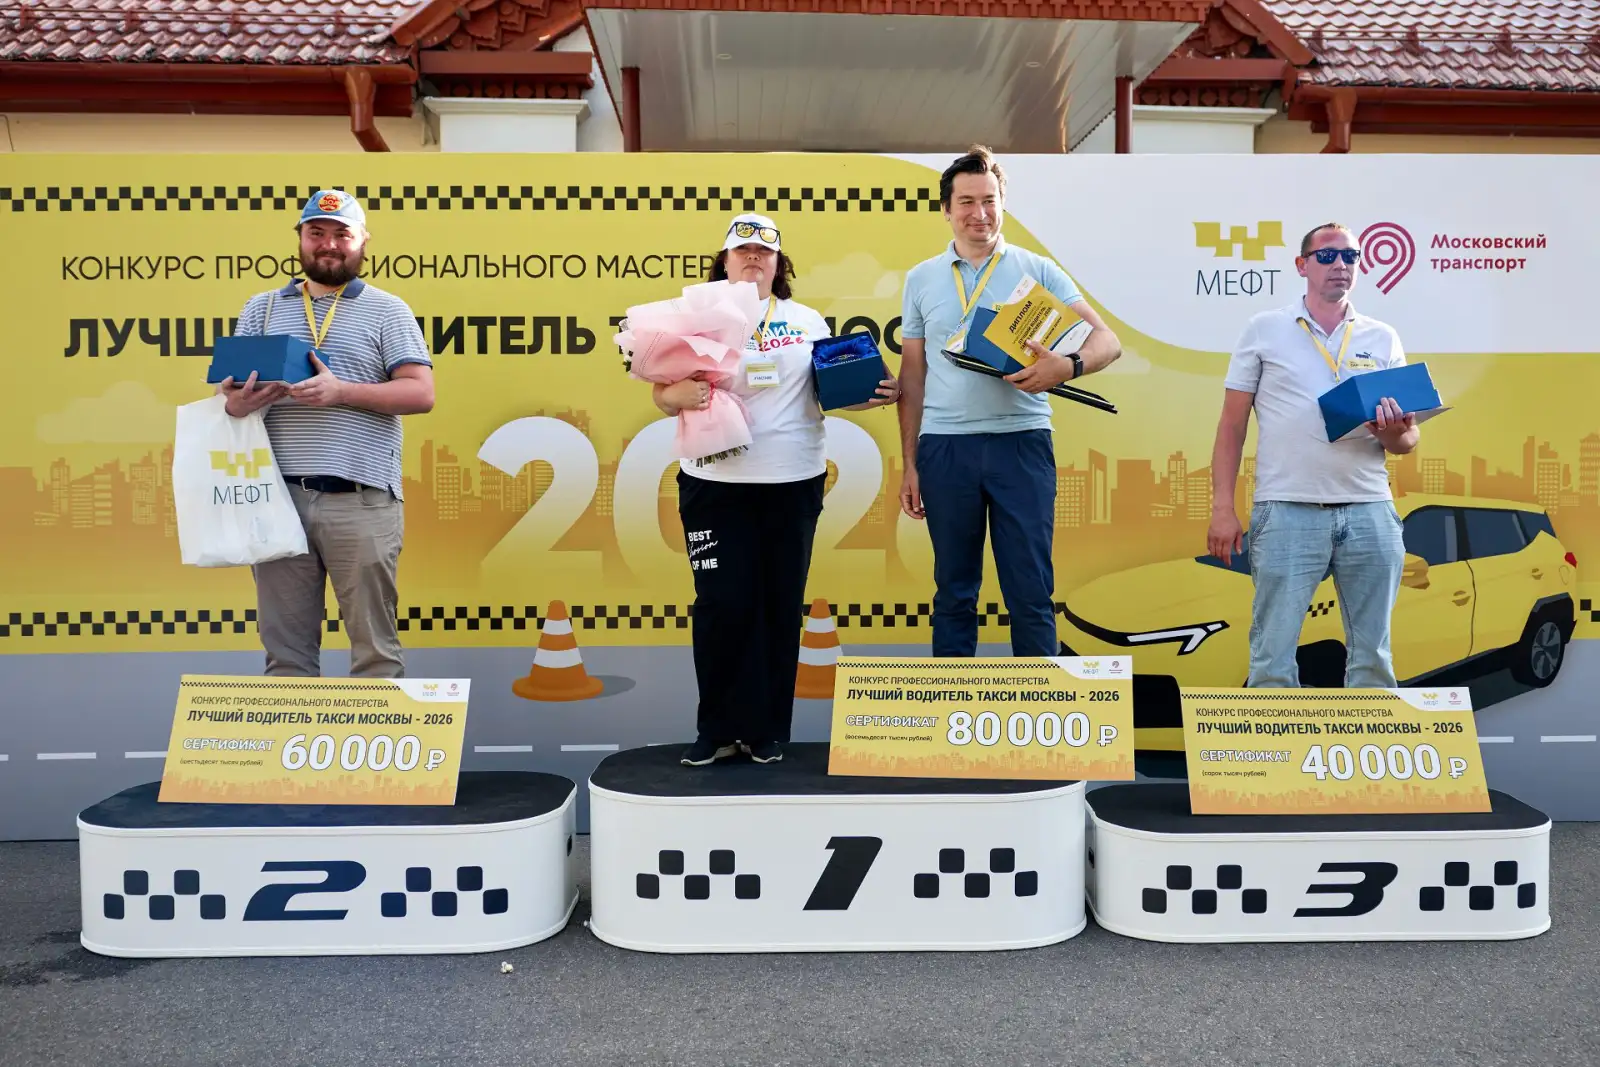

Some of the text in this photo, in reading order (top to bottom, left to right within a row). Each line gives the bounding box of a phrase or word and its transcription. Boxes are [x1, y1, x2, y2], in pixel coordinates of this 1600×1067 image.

[1430, 233, 1548, 250] Московский
[62, 256, 206, 280] КОНКУРС
[215, 254, 587, 279] ПРОФИОНАЛЬНОГО
[1430, 257, 1527, 273] транспорт
[1196, 269, 1282, 297] МЕФТ
[1009, 300, 1033, 333] ДИПЛОМ
[213, 483, 273, 505] МЕФТ
[688, 530, 712, 542] BEST
[692, 558, 718, 571] OF ME
[849, 676, 1049, 686] КОНКУРС ПРОФЕССИОНАЛЬНОГО МАСТЕРСТВА
[191, 696, 389, 708] КОНКУРС ПРОФЕССИОНАЛЬНОГО МАСТЕРСТВА
[847, 688, 903, 701] ЛУЧШИЙ
[906, 690, 973, 703] ВОДИТЕЛЬ
[977, 691, 1017, 702] ТАКСИ
[1020, 691, 1077, 702] МОСКВЫ
[1089, 691, 1120, 702] 2026
[187, 708, 243, 722] ЛУЧШИЙ
[246, 712, 312, 725] ВОДИТЕЛЬ
[316, 712, 355, 724] ТАКСИ
[359, 713, 413, 725] МОСКВЫ
[423, 713, 453, 725] 2026
[1196, 708, 1393, 718] КОНКУРС ПРОФЕССИОНАЛЬНОГО МАСТЕРСТВА
[846, 715, 939, 728] СЕРТИФИКАТ
[1197, 720, 1252, 734] ЛУЧШИЙ
[1256, 723, 1321, 736] ВОДИТЕЛЬ
[1324, 723, 1363, 734] ТАКСИ
[1367, 723, 1421, 734] МОСКВЫ
[1433, 722, 1463, 733] 2026
[183, 738, 275, 752] СЕРТИФИКАТ
[1200, 749, 1291, 762] СЕРТИФИКАТ
[803, 836, 883, 910] 1
[242, 860, 367, 921] 2
[1293, 862, 1399, 917] 3
